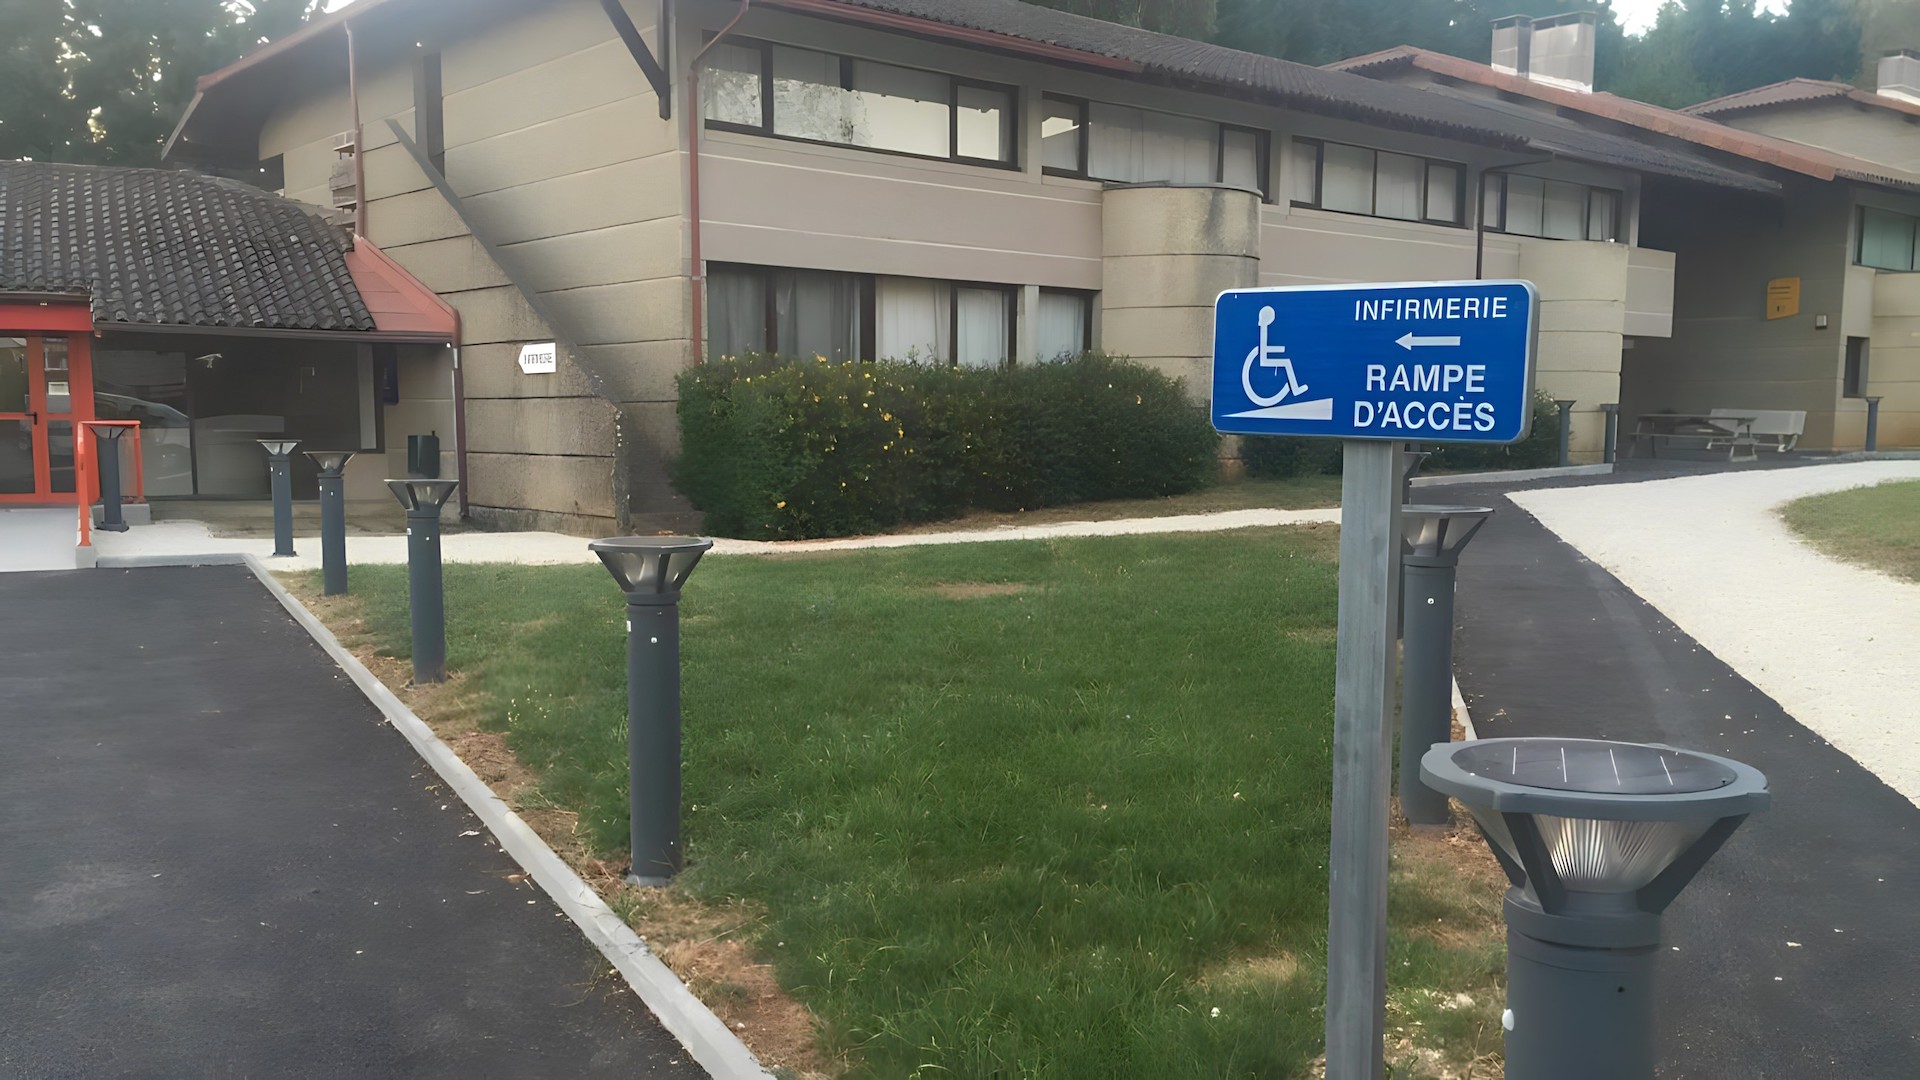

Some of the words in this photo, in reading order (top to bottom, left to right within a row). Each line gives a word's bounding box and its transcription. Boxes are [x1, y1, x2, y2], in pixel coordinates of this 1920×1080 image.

[1355, 297, 1508, 321] INFIRMERIE
[1366, 364, 1486, 392] RAMPE
[1353, 396, 1496, 431] D'ACCÈS
